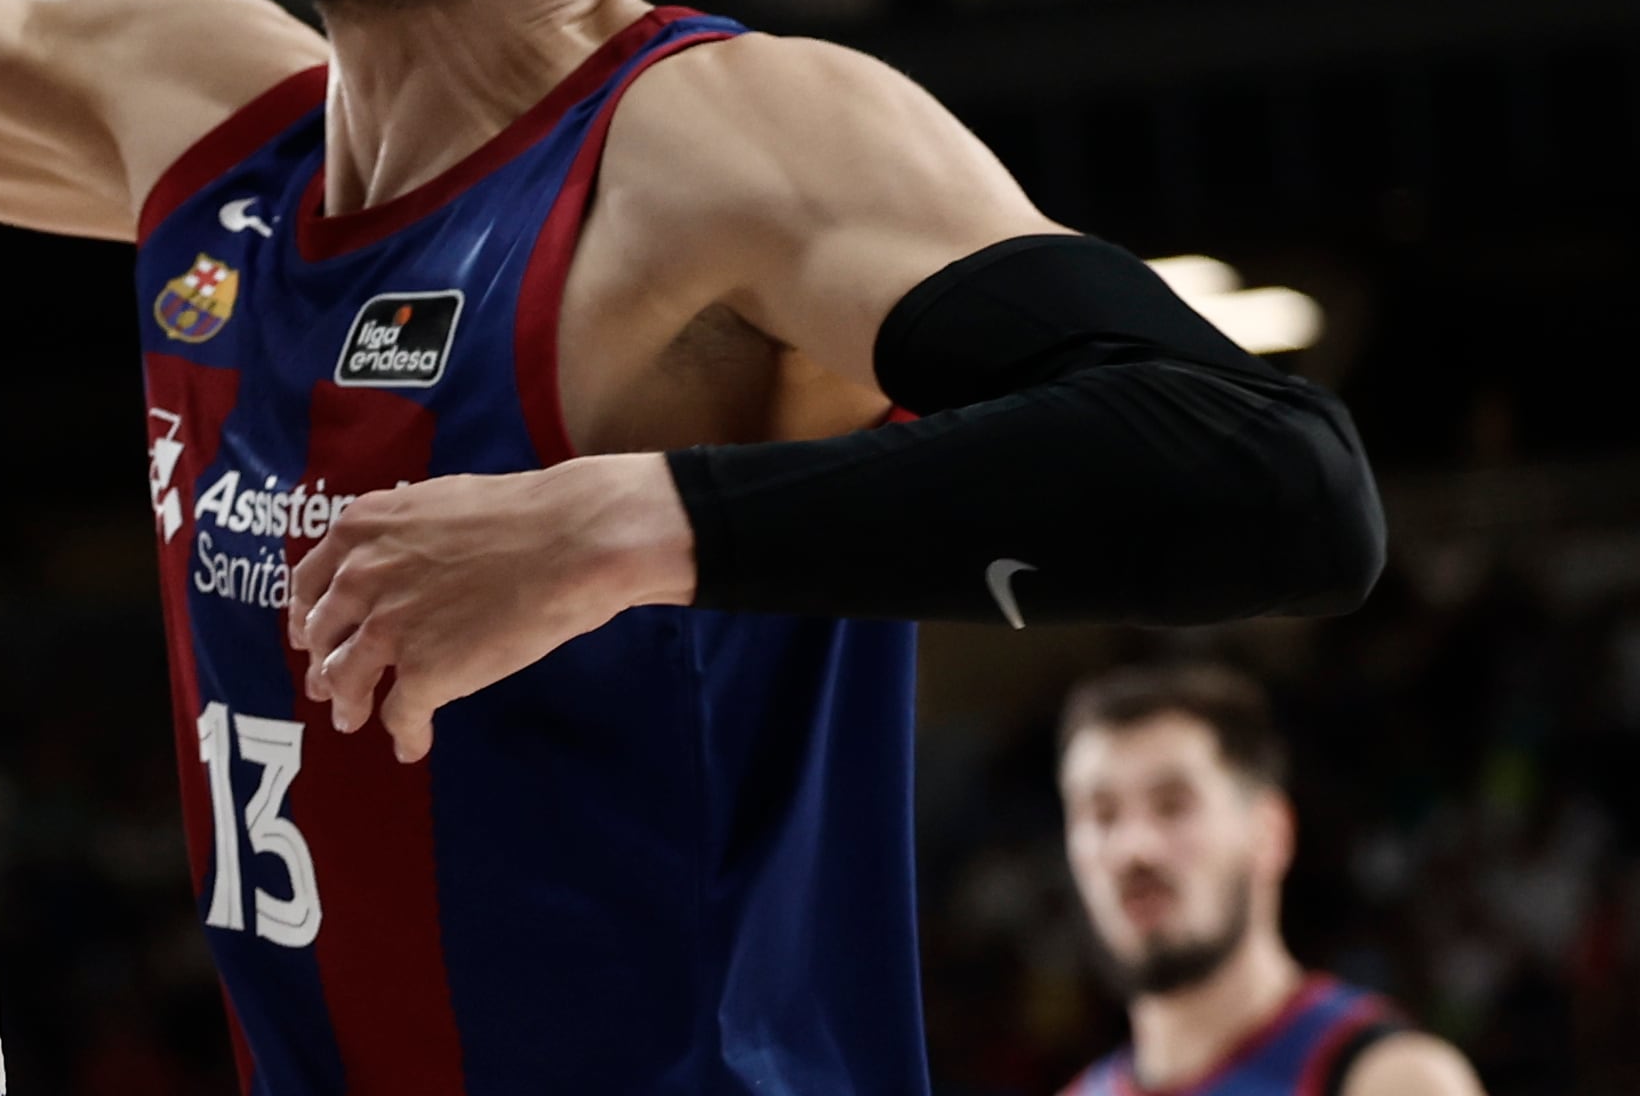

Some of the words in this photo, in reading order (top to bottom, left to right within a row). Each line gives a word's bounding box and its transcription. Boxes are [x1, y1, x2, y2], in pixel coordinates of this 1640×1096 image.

[348, 344, 439, 372] endesa
[357, 319, 401, 350] liga
[194, 530, 292, 609] Sanità
[196, 701, 322, 948] 13
